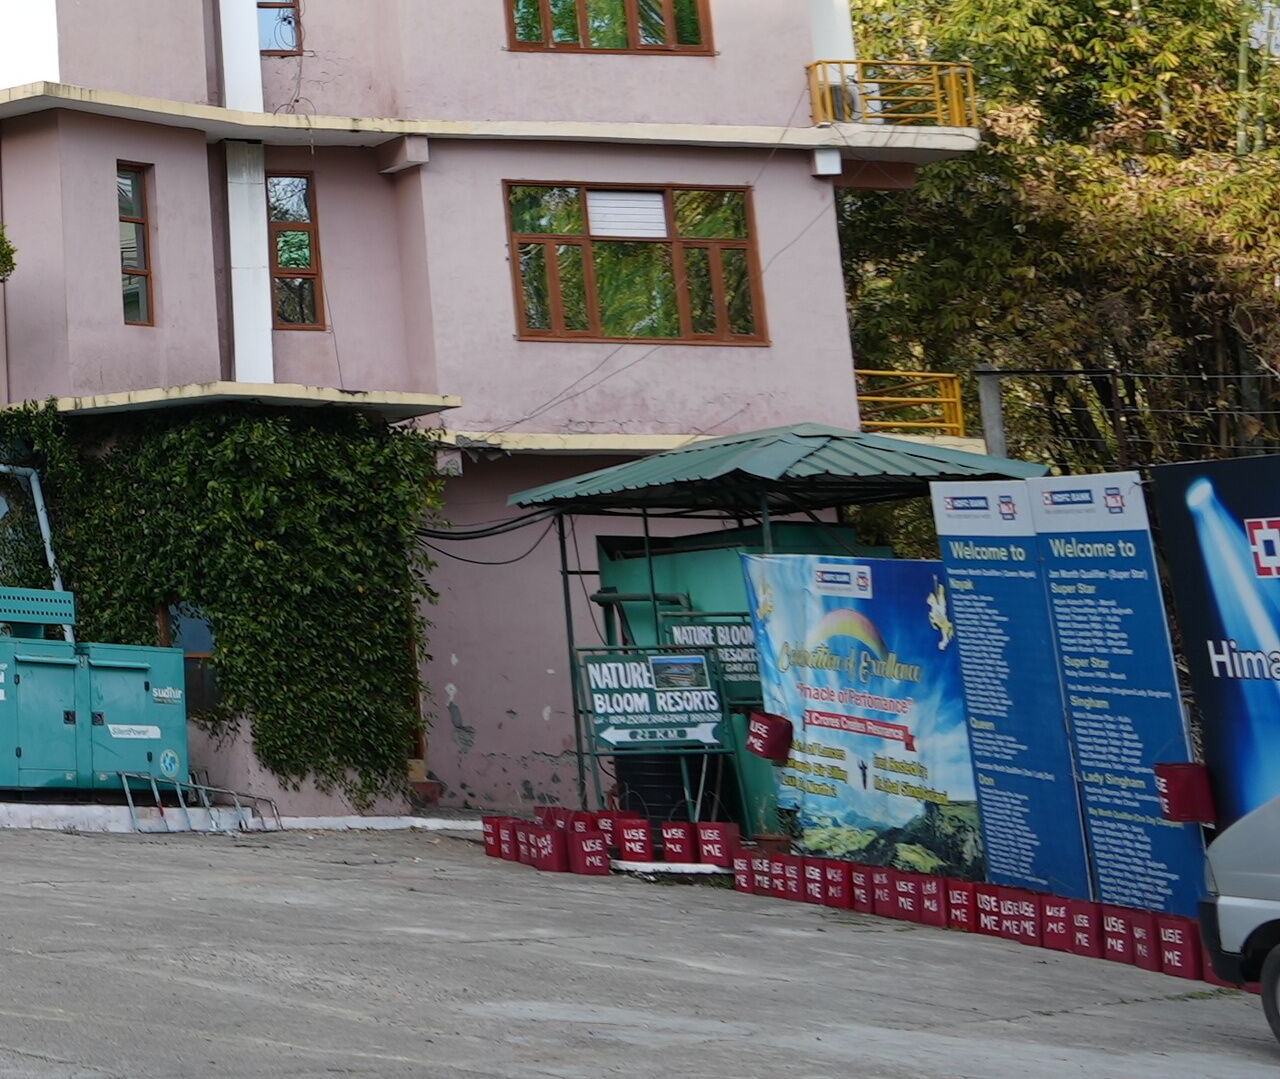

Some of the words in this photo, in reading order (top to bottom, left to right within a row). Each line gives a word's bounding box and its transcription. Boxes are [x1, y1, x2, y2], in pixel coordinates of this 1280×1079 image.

[949, 540, 1009, 561] Welcome
[1010, 545, 1027, 562] to
[1049, 538, 1115, 558] Welcome
[1118, 539, 1137, 558] to
[1050, 582, 1076, 596] Super
[1077, 582, 1096, 594] Star
[672, 625, 715, 645] NATURE
[1063, 655, 1090, 668] Super
[1090, 656, 1109, 669] Star
[587, 662, 655, 690] NATURE
[594, 692, 651, 714] BLOOM
[656, 691, 719, 713] RESORTS
[750, 721, 769, 738] USE
[747, 736, 765, 752] ME
[1082, 771, 1104, 786] Lady
[1105, 773, 1146, 789] Singham
[624, 828, 647, 840] USE
[662, 828, 686, 839] USE
[701, 829, 721, 841] USE
[582, 839, 603, 852] USE
[625, 842, 645, 853] ME
[703, 843, 723, 857] ME
[586, 855, 603, 867] ME
[733, 858, 748, 871] USE
[751, 858, 770, 873] USE
[771, 862, 784, 875] USE
[785, 864, 798, 879] USE
[804, 865, 822, 881] USE
[826, 866, 843, 882] USE
[852, 871, 866, 886] USE
[873, 873, 888, 885] USE
[735, 874, 748, 888] ME
[754, 874, 770, 889] ME
[772, 878, 785, 891] ME
[787, 879, 798, 893] ME
[895, 880, 916, 894] USE
[922, 880, 937, 895] USE
[806, 882, 822, 899] ME
[854, 888, 868, 903] ME
[874, 888, 890, 902] ME
[949, 890, 969, 905] USE
[898, 896, 914, 911] ME
[977, 893, 1000, 912] USE
[1000, 900, 1019, 916] USE
[1019, 901, 1036, 917] USE
[950, 908, 968, 923] ME
[1046, 905, 1066, 917] USE
[980, 913, 1000, 932] ME
[1002, 919, 1019, 935] ME
[1020, 919, 1037, 937] ME
[1074, 914, 1091, 928] USE
[1103, 915, 1126, 935] USE
[1075, 931, 1090, 947] ME
[1161, 928, 1184, 944] USE
[1107, 937, 1124, 953] ME
[1164, 950, 1183, 967] ME
